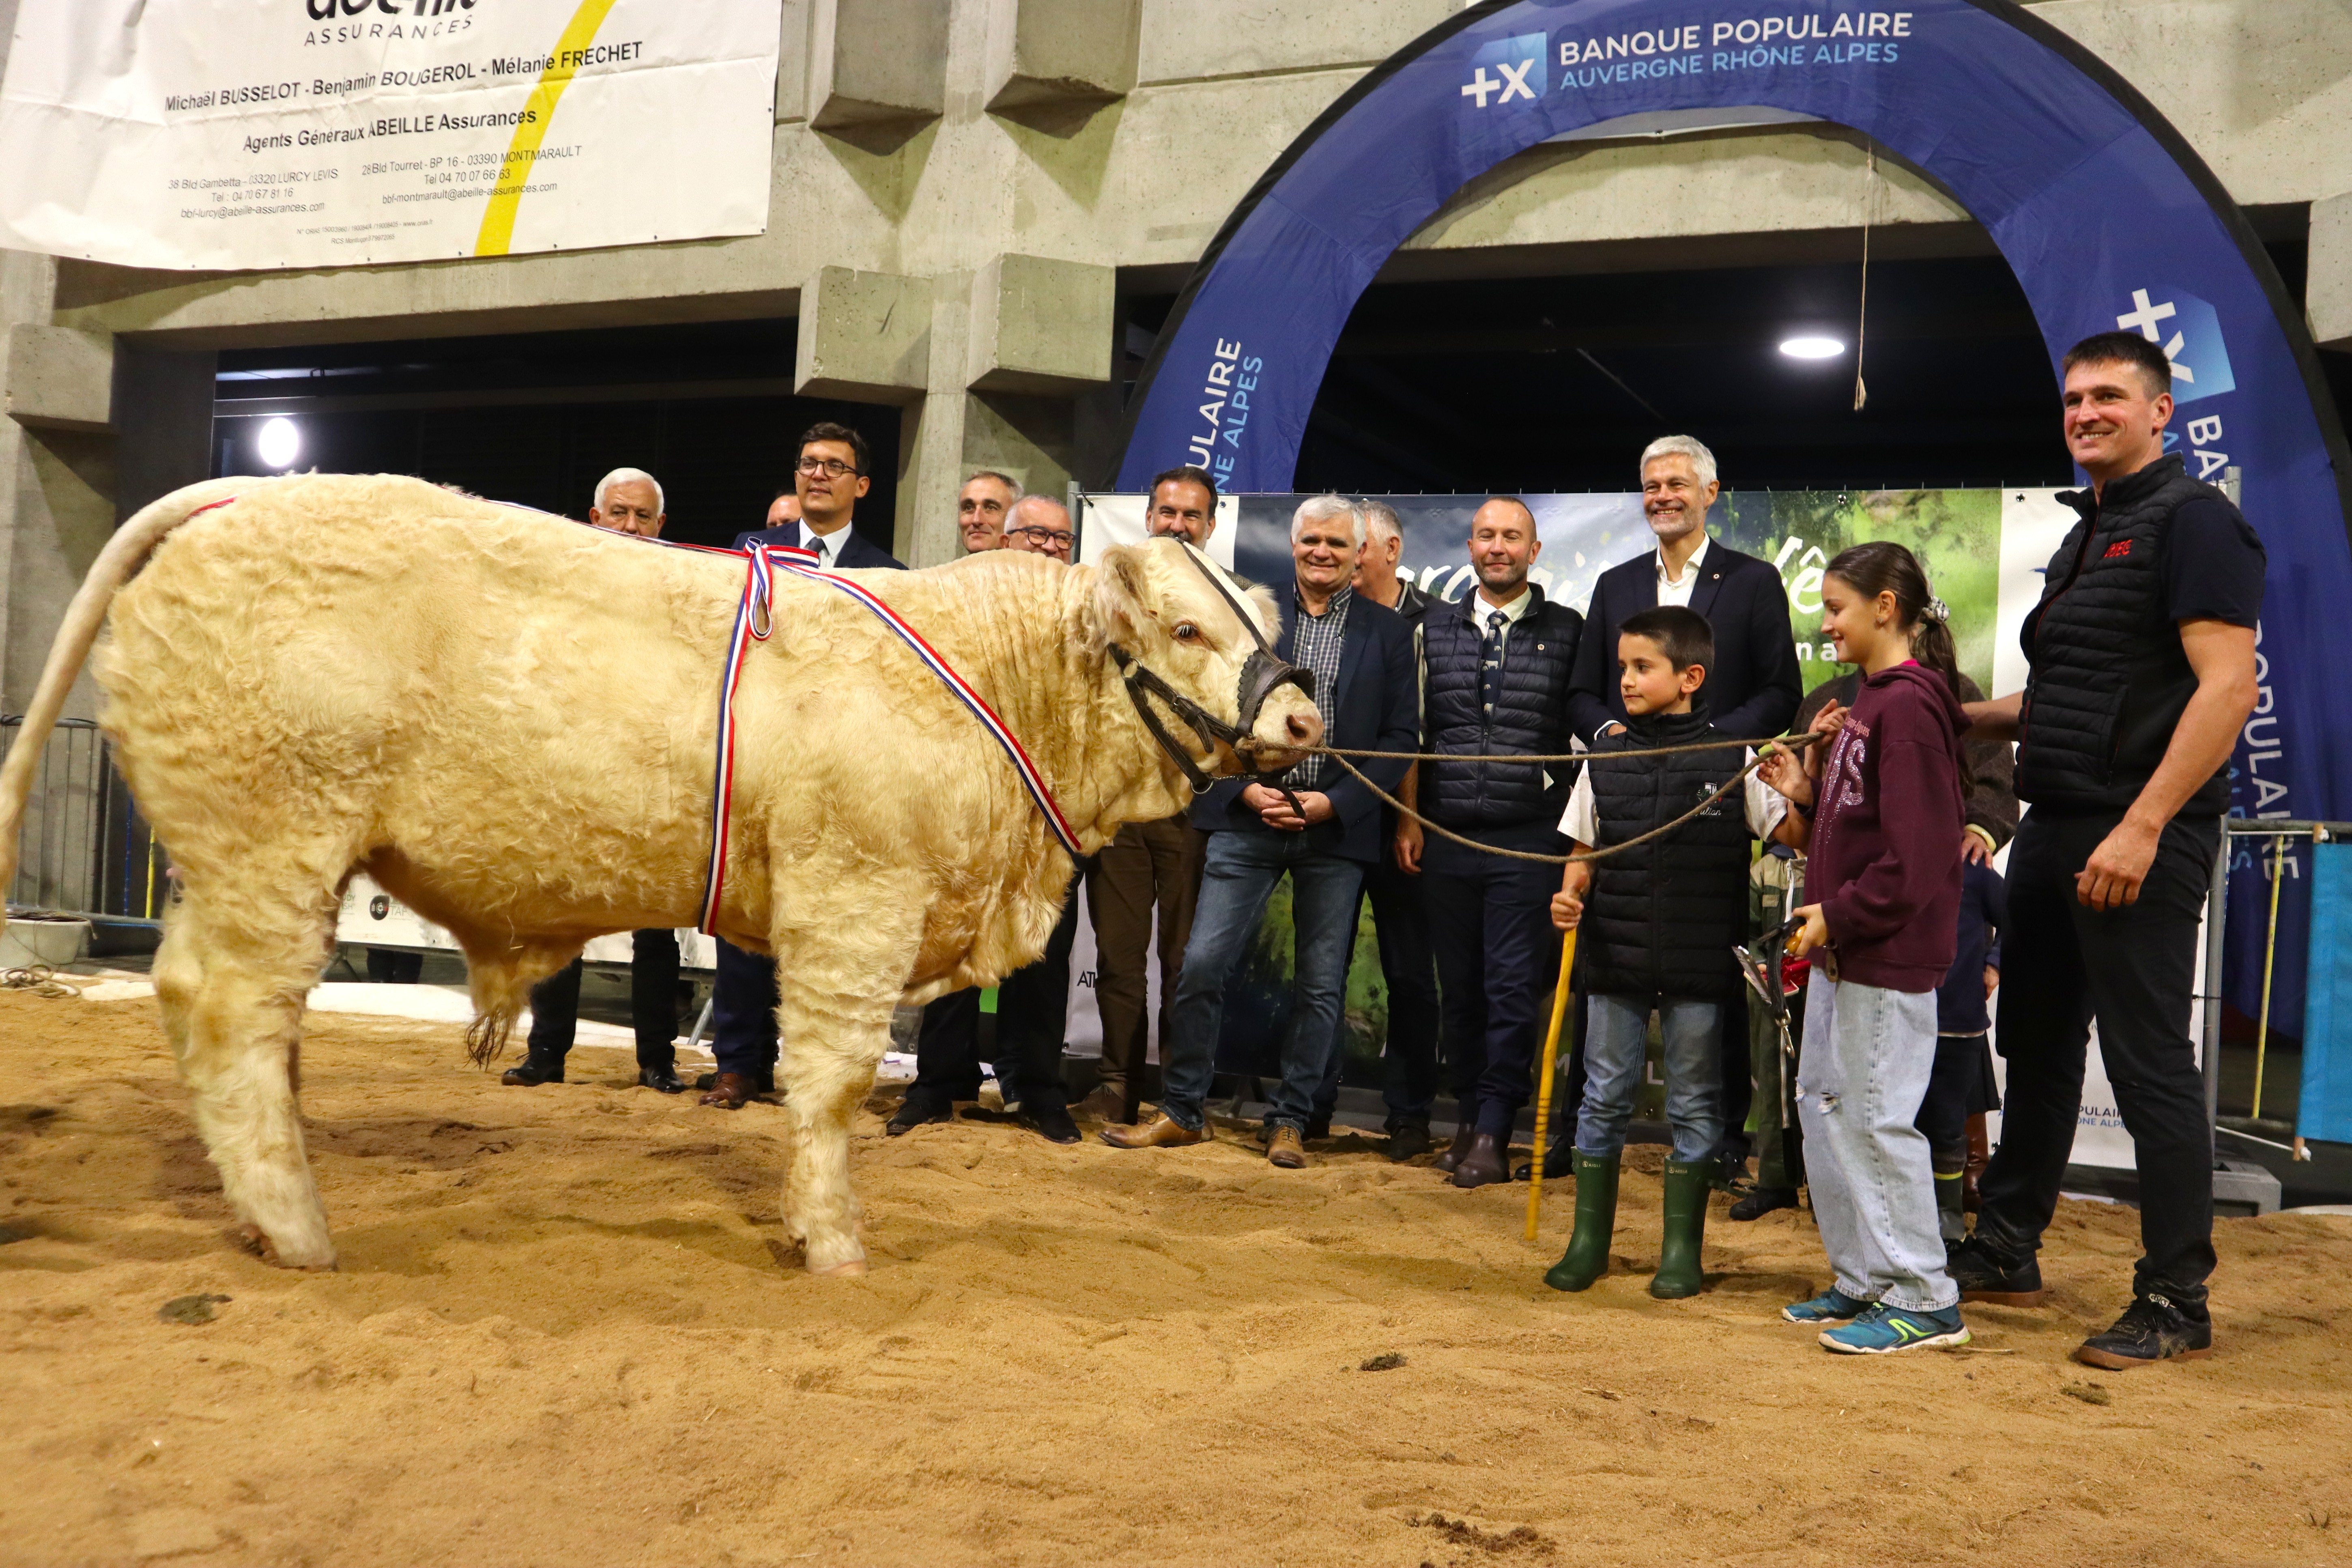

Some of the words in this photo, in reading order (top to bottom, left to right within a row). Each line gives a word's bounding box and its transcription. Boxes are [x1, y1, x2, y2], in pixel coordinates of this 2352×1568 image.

[304, 15, 472, 46] ASSURANCES
[1560, 25, 1701, 66] BANQUE
[1712, 12, 1913, 46] POPULAIRE
[165, 91, 215, 112] Michaël
[220, 82, 301, 105] BUSSELOT
[312, 73, 376, 97] Benjamin
[381, 63, 476, 86] BOUGEROL
[492, 54, 555, 75] Mélanie
[560, 41, 643, 68] FRECHET
[1560, 54, 1703, 90] AUVERGNE
[1712, 44, 1806, 71] RHÔNE
[1812, 43, 1899, 64] ALPES
[243, 134, 292, 153] Agents
[298, 127, 365, 146] Généraux
[368, 116, 434, 137] ABEILLE
[438, 110, 537, 130] Assurances
[390, 159, 423, 171] Tourret
[430, 157, 443, 168] BP
[447, 156, 458, 167] 16
[467, 153, 497, 166] 03390
[500, 146, 583, 163] MONTMARAULT
[168, 180, 179, 189] 38
[181, 179, 198, 189] Bld
[199, 179, 241, 189] Gambetta
[249, 174, 276, 185] 03320
[278, 172, 311, 183] LURCY
[313, 168, 338, 181] LEVIS
[424, 174, 437, 185] Tel
[439, 172, 452, 183] 04
[455, 172, 467, 182] 70
[469, 170, 480, 181] 07
[482, 170, 496, 180] 66
[499, 168, 511, 179] 63
[212, 192, 224, 202] Tel
[232, 191, 242, 201] 04
[245, 189, 253, 200] 70
[255, 189, 268, 199] 67
[270, 189, 280, 198] 81
[284, 187, 294, 198] 16
[382, 182, 557, 204] bbf-montmarault@abeille-assurances.com
[181, 202, 325, 219] bbf-lurcy@abeille-assurances.com
[1185, 338, 1241, 471] ULAIRE
[1223, 355, 1263, 449] ALPES
[1696, 807, 1722, 816] ulian
